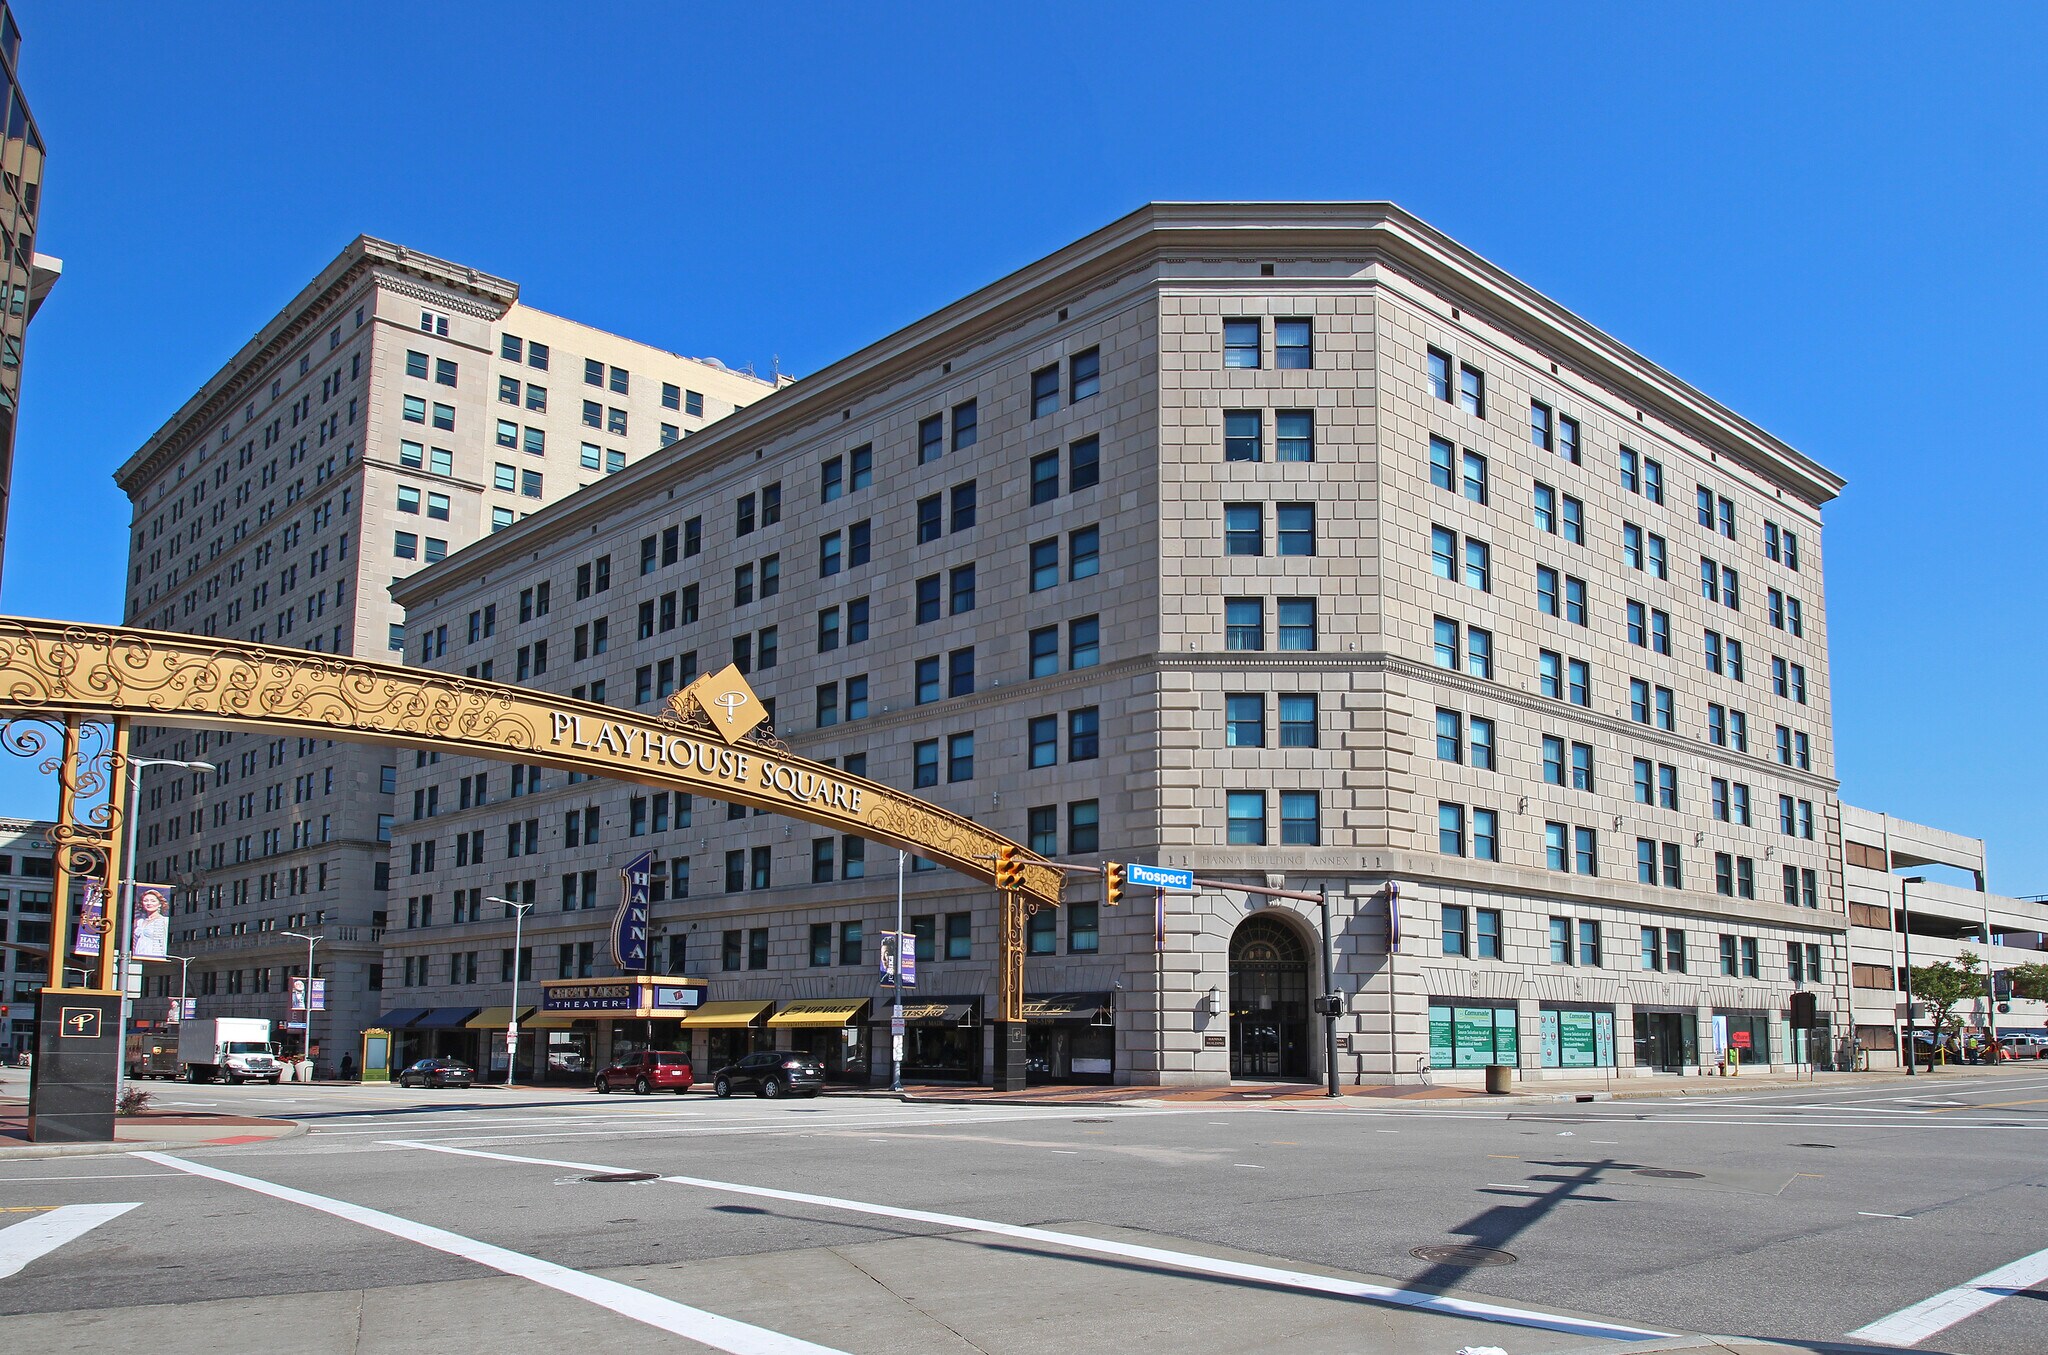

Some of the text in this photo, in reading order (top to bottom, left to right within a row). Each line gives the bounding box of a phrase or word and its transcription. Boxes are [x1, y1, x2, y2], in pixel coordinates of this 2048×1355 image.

[550, 711, 862, 813] PLAYHOUSE SQUARE
[1202, 855, 1350, 866] HANNA BUILDING ANNEX
[1133, 866, 1188, 886] Prospect
[628, 870, 649, 960] HANNA
[548, 985, 630, 999] GREAT LAKES
[555, 1000, 619, 1008] THEATER
[805, 1005, 856, 1014] VIP VALET
